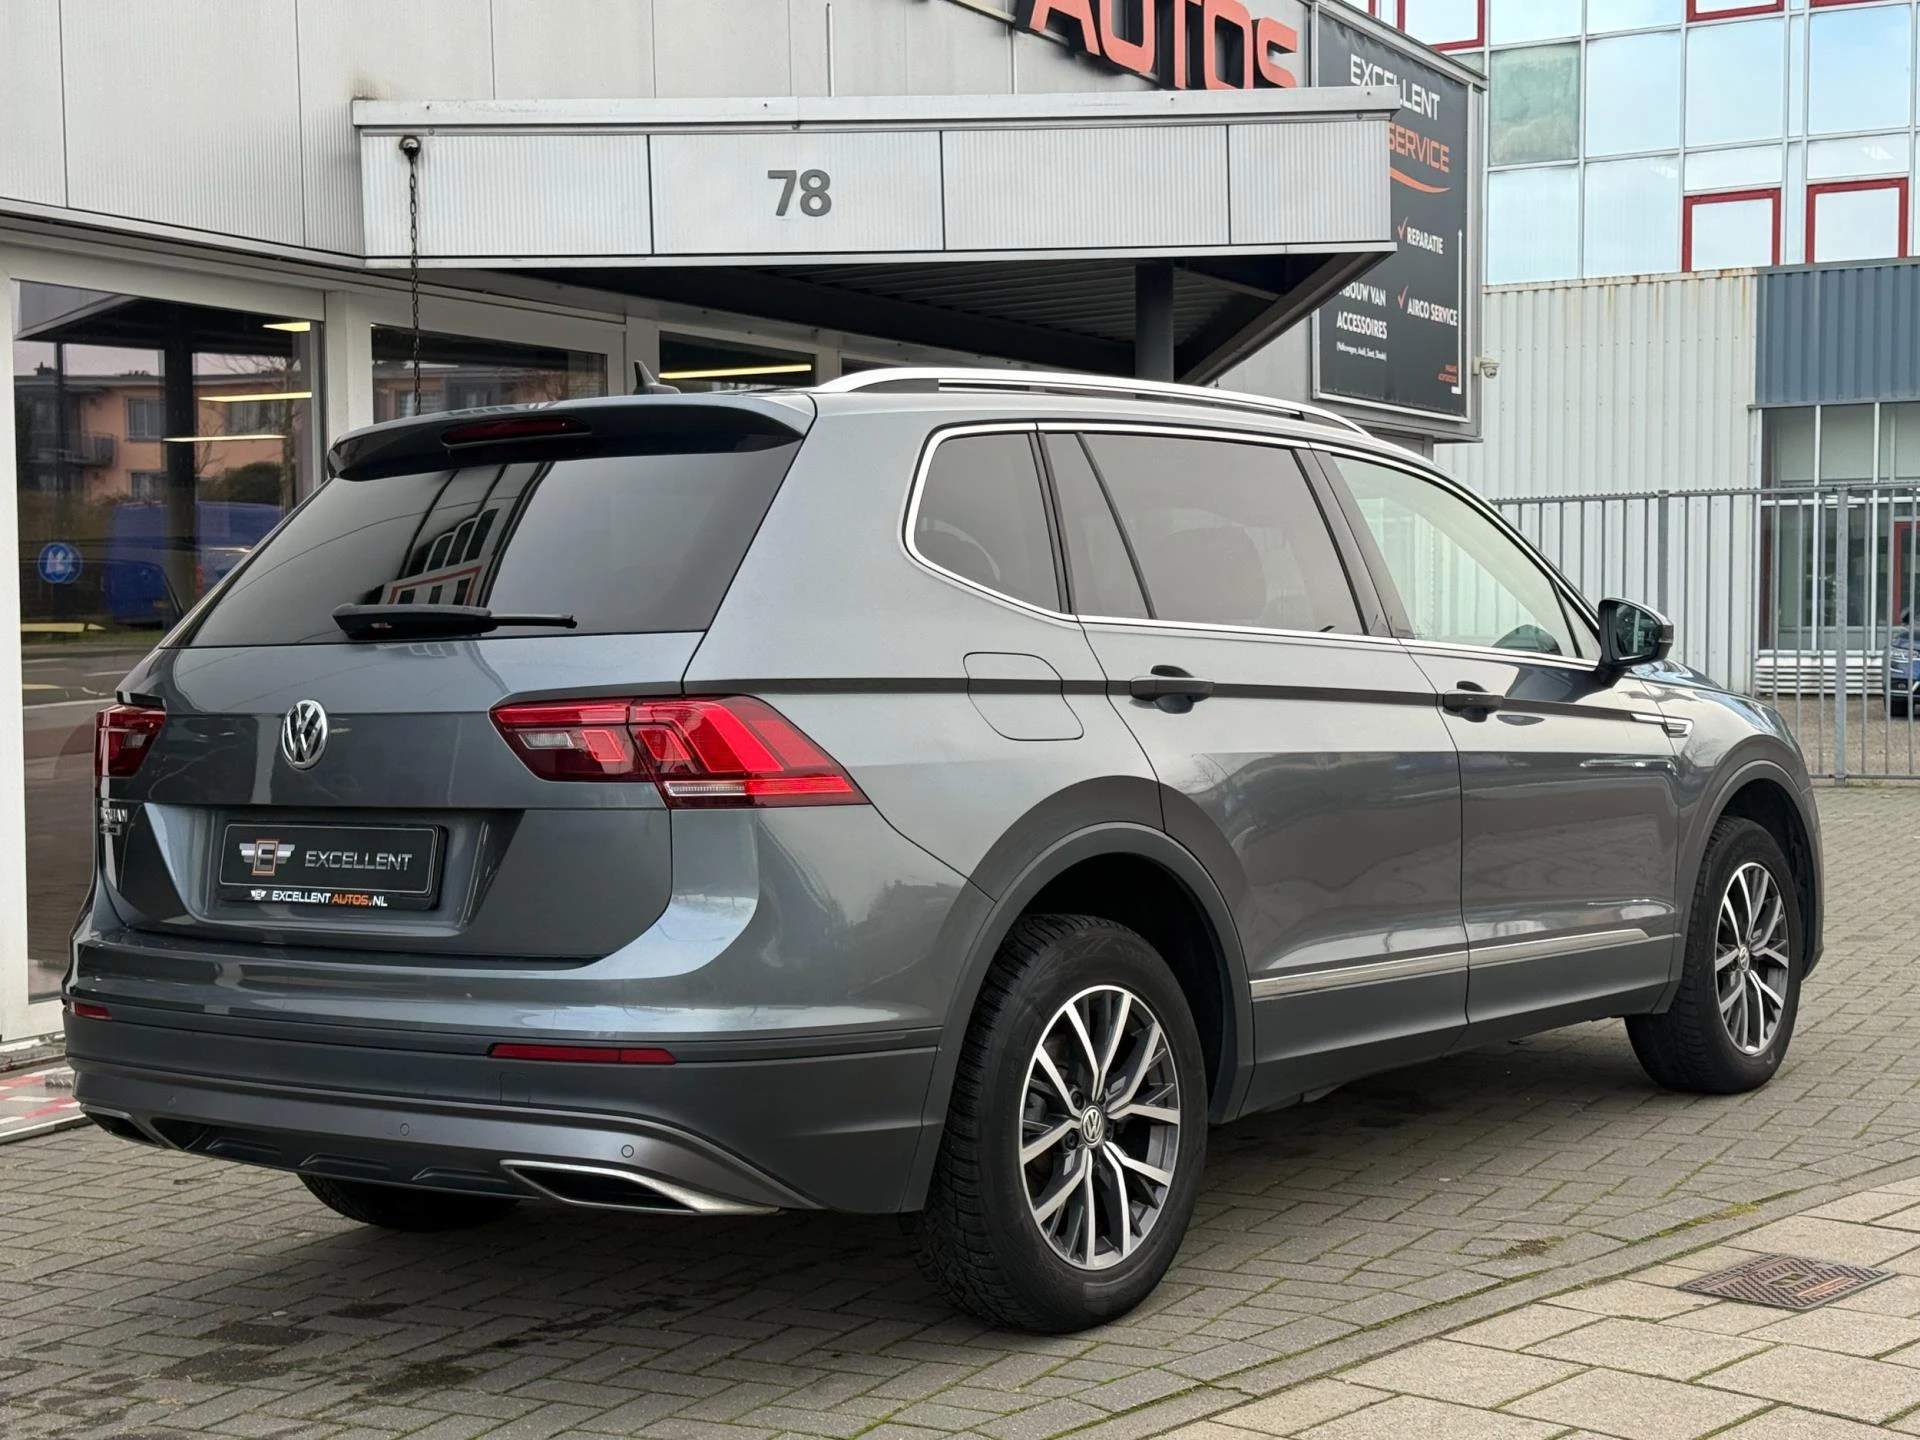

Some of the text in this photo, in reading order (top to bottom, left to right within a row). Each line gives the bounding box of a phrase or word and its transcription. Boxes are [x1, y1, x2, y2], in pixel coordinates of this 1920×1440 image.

[1389, 121, 1450, 173] SERVICE
[767, 168, 832, 217] 78
[1406, 226, 1444, 255] REPARATIE
[1370, 285, 1387, 307] VAN
[1336, 311, 1388, 340] ACCESSOIRES
[1407, 297, 1458, 327] AIRCO SERVICE
[305, 849, 413, 871] EXCELLENT
